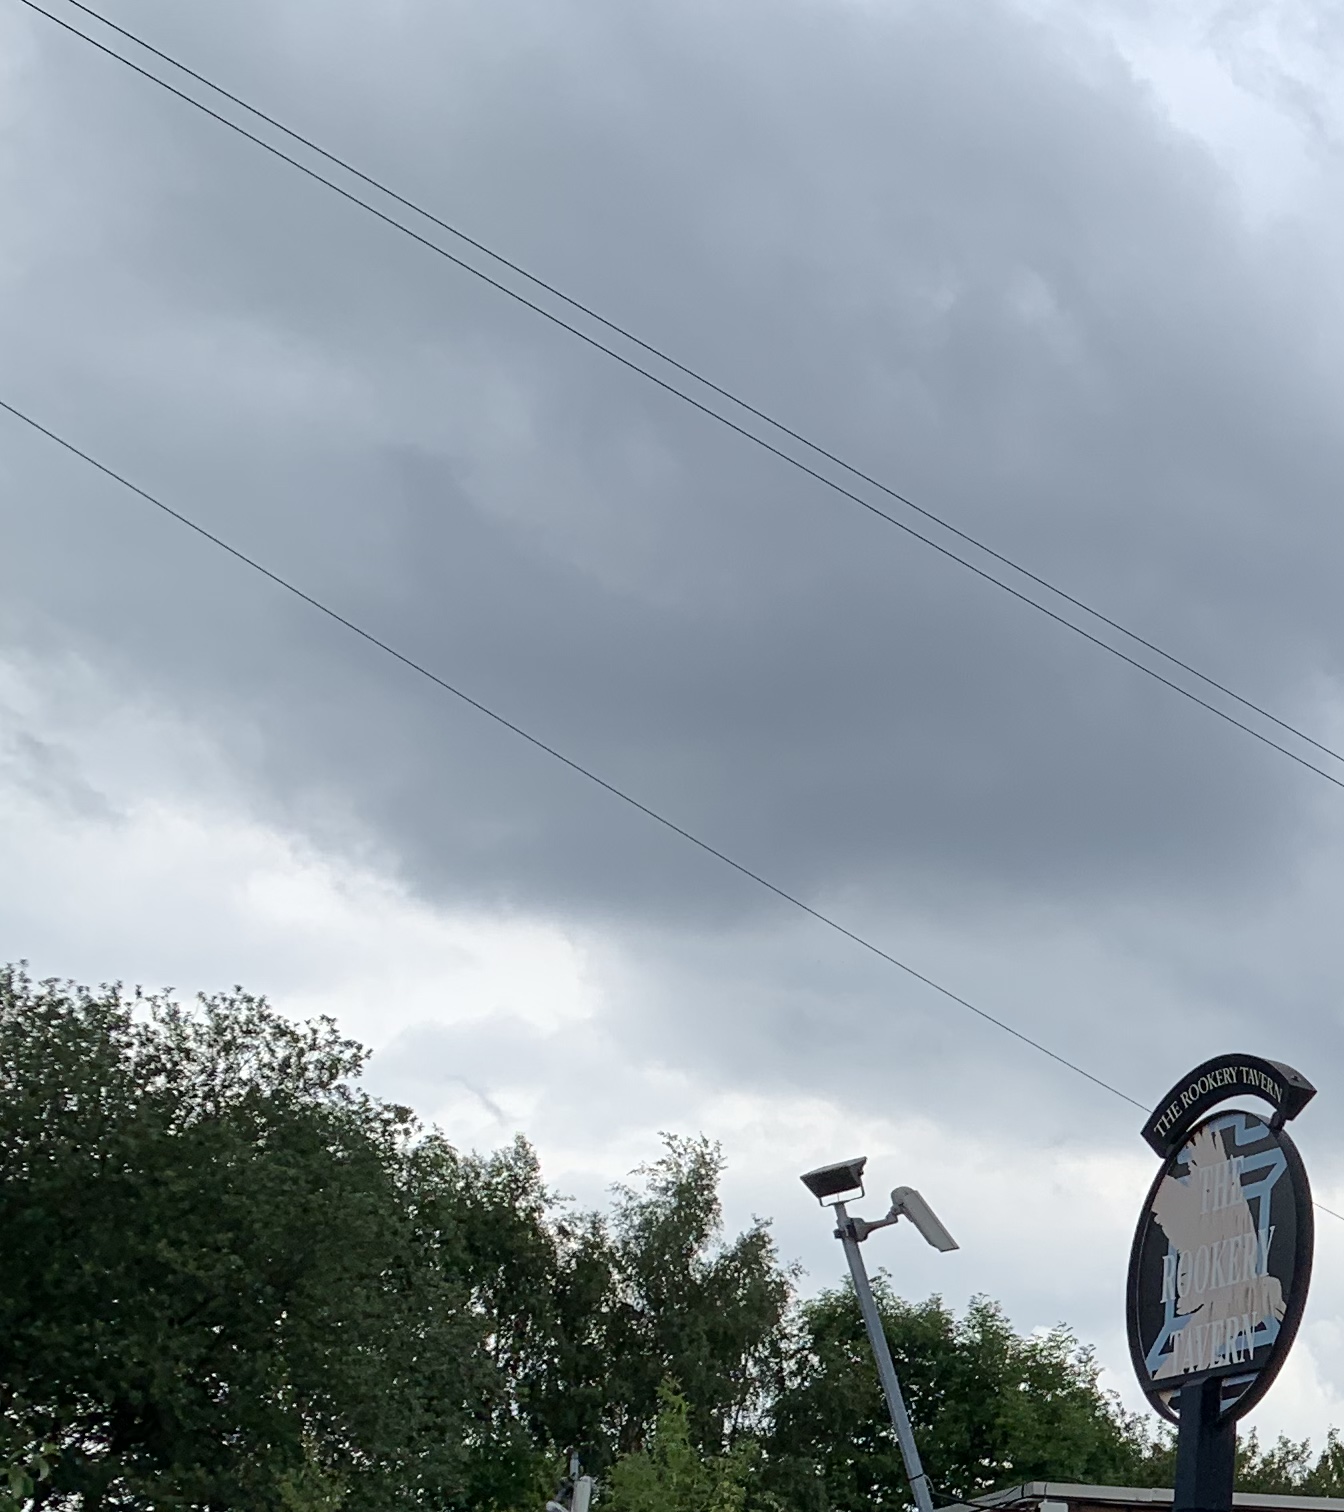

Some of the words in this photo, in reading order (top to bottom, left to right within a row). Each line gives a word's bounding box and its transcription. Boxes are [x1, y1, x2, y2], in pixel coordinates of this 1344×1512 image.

[1153, 1100, 1183, 1137] THE
[1180, 1066, 1238, 1109] ROOKERY
[1240, 1066, 1283, 1103] TAVERN
[1198, 1155, 1245, 1215] THE
[1160, 1225, 1276, 1304] ROOKERY
[1169, 1311, 1259, 1375] TAVERN
